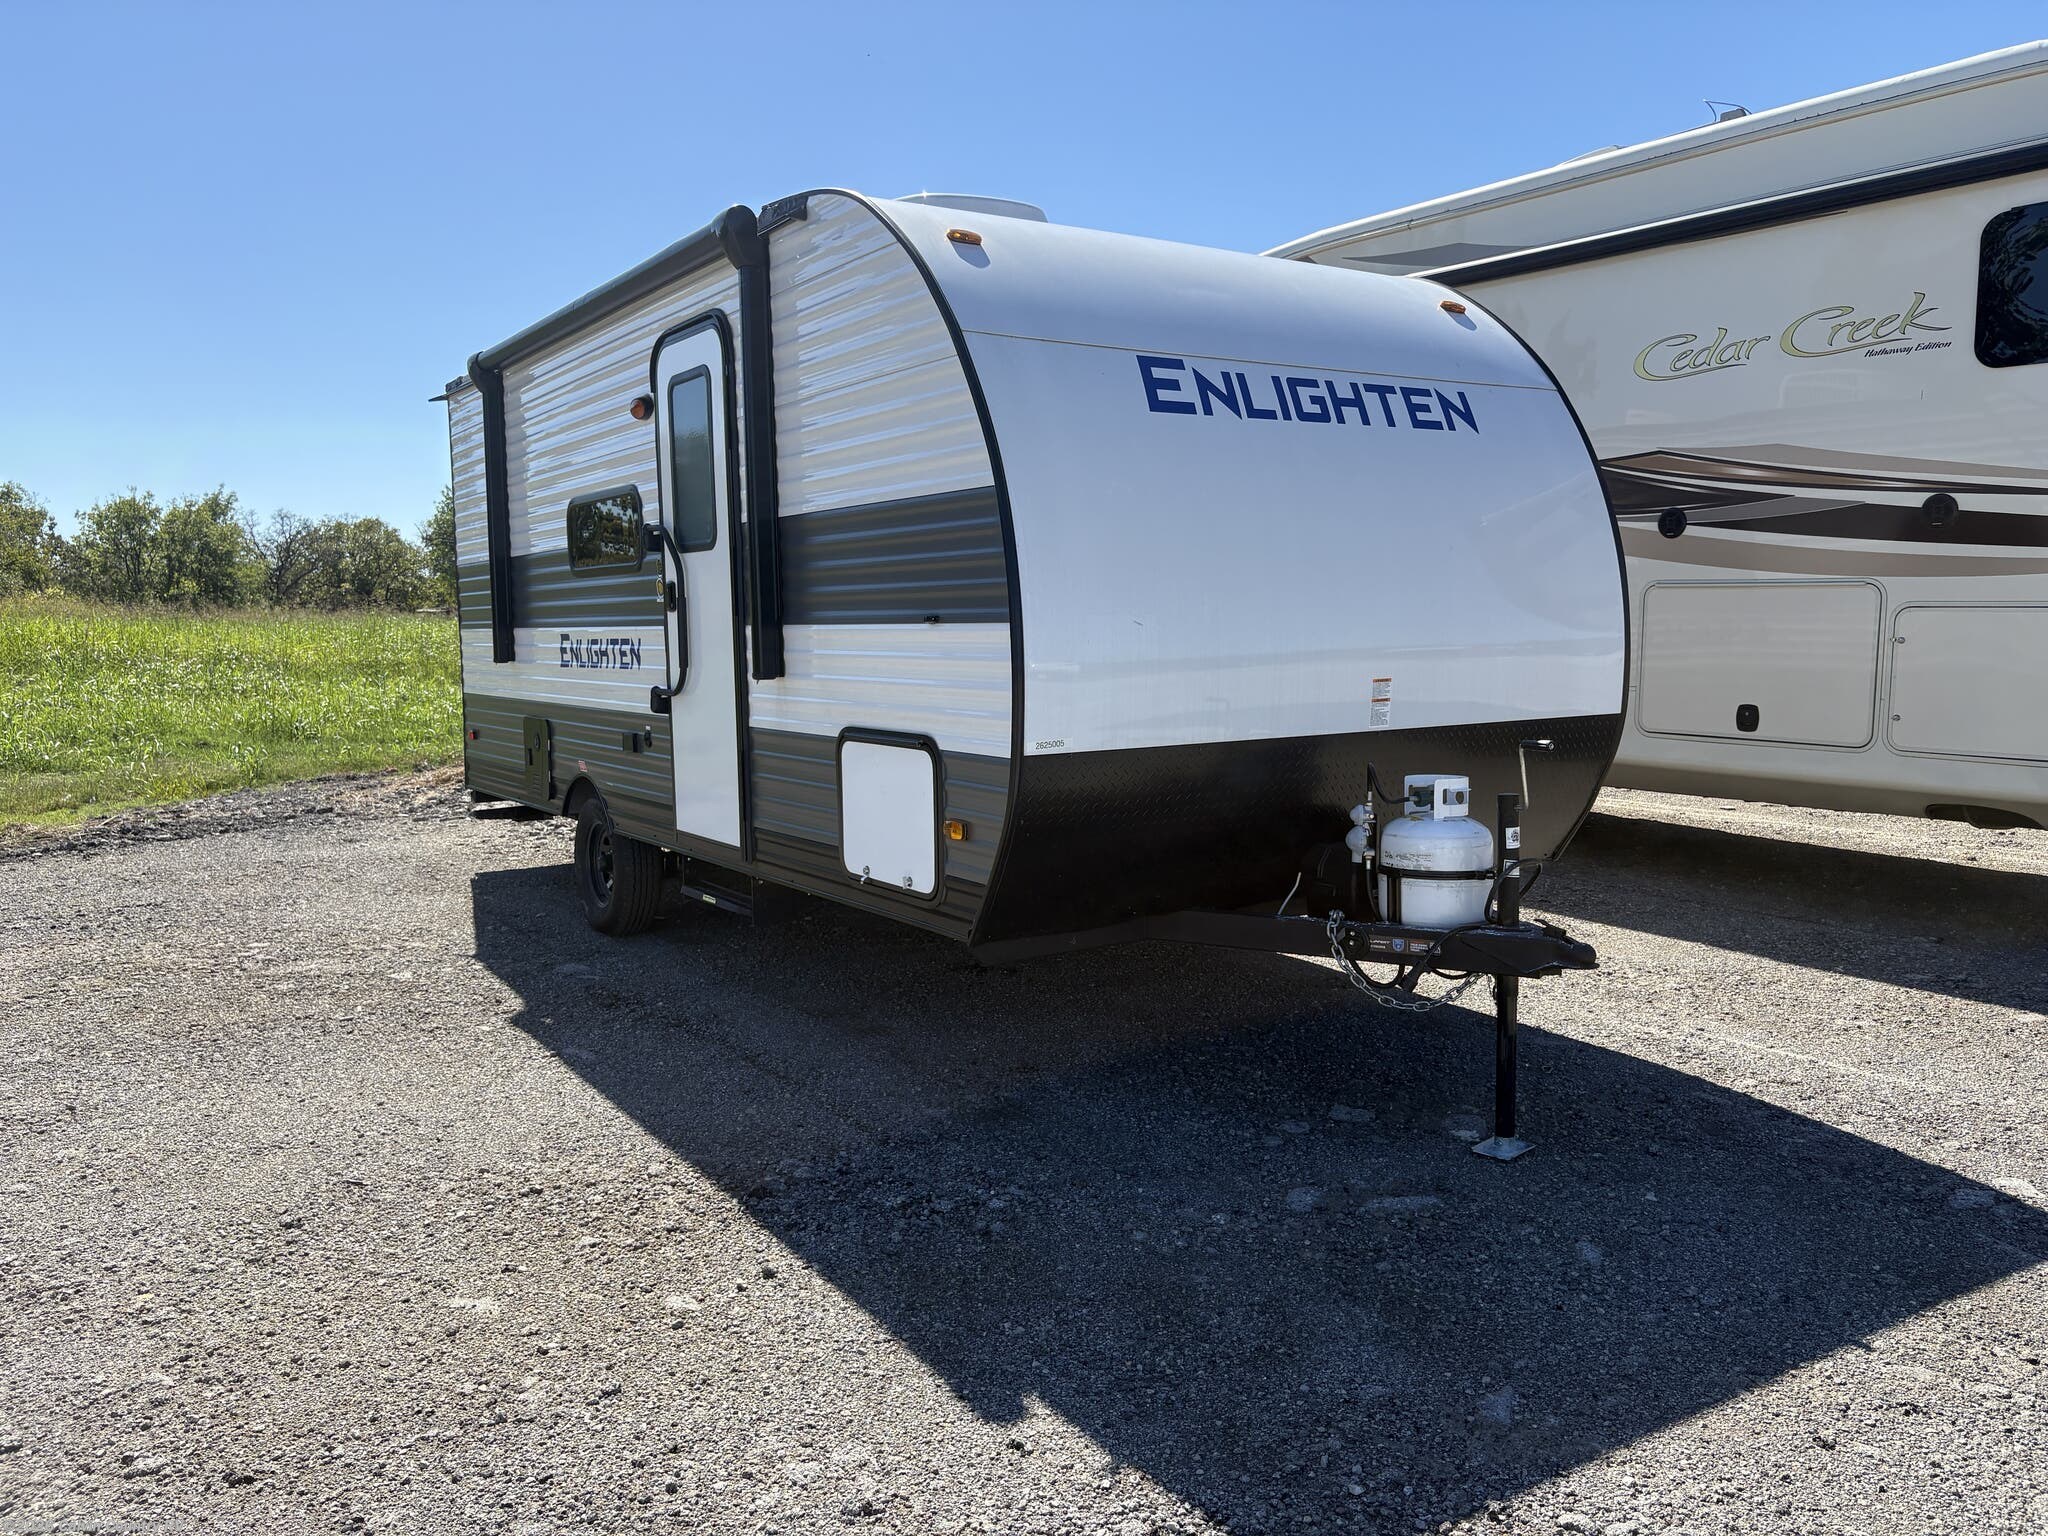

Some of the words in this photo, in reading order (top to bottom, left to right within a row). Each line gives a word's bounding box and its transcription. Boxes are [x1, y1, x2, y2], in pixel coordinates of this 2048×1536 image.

[1633, 328, 1770, 381] Cedar
[1779, 292, 1952, 357] Creek
[1864, 346, 1913, 358] Hathaway
[1914, 341, 1952, 352] Edition
[1135, 354, 1480, 434] ENLIGHTEN
[559, 633, 642, 670] ENLIGHTEN
[1035, 739, 1065, 750] 2625005
